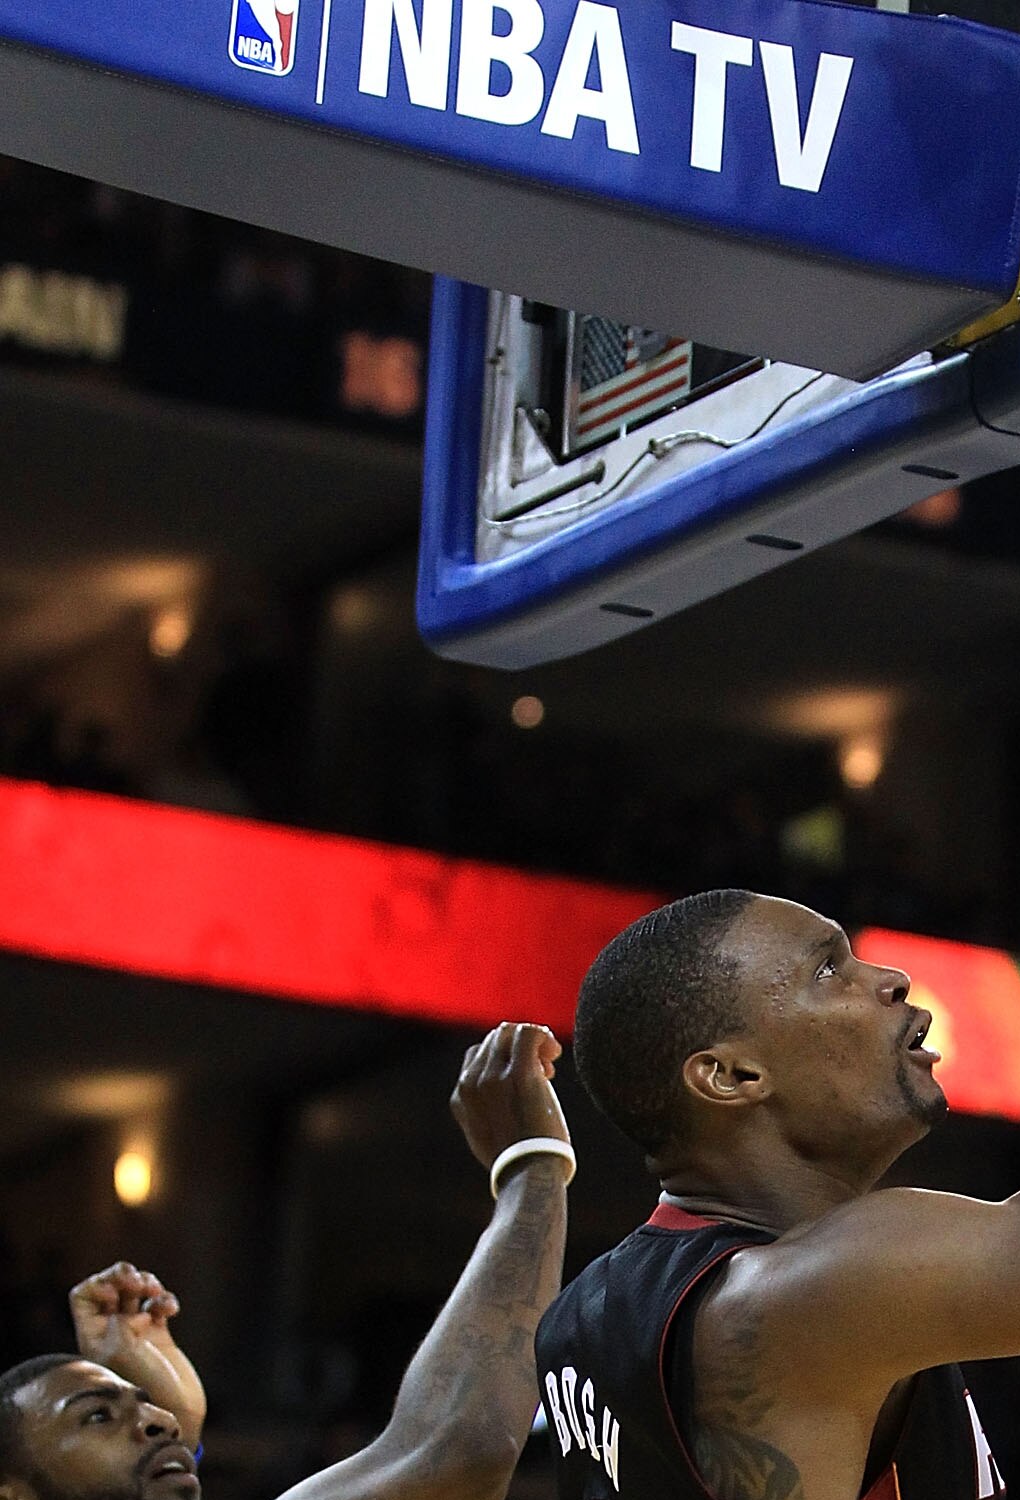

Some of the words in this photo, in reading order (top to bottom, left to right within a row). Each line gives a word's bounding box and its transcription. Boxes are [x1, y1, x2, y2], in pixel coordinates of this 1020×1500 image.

[237, 35, 273, 63] NBA
[358, 0, 640, 155] NBA
[671, 21, 854, 192] TV
[545, 1367, 620, 1492] BOSH
